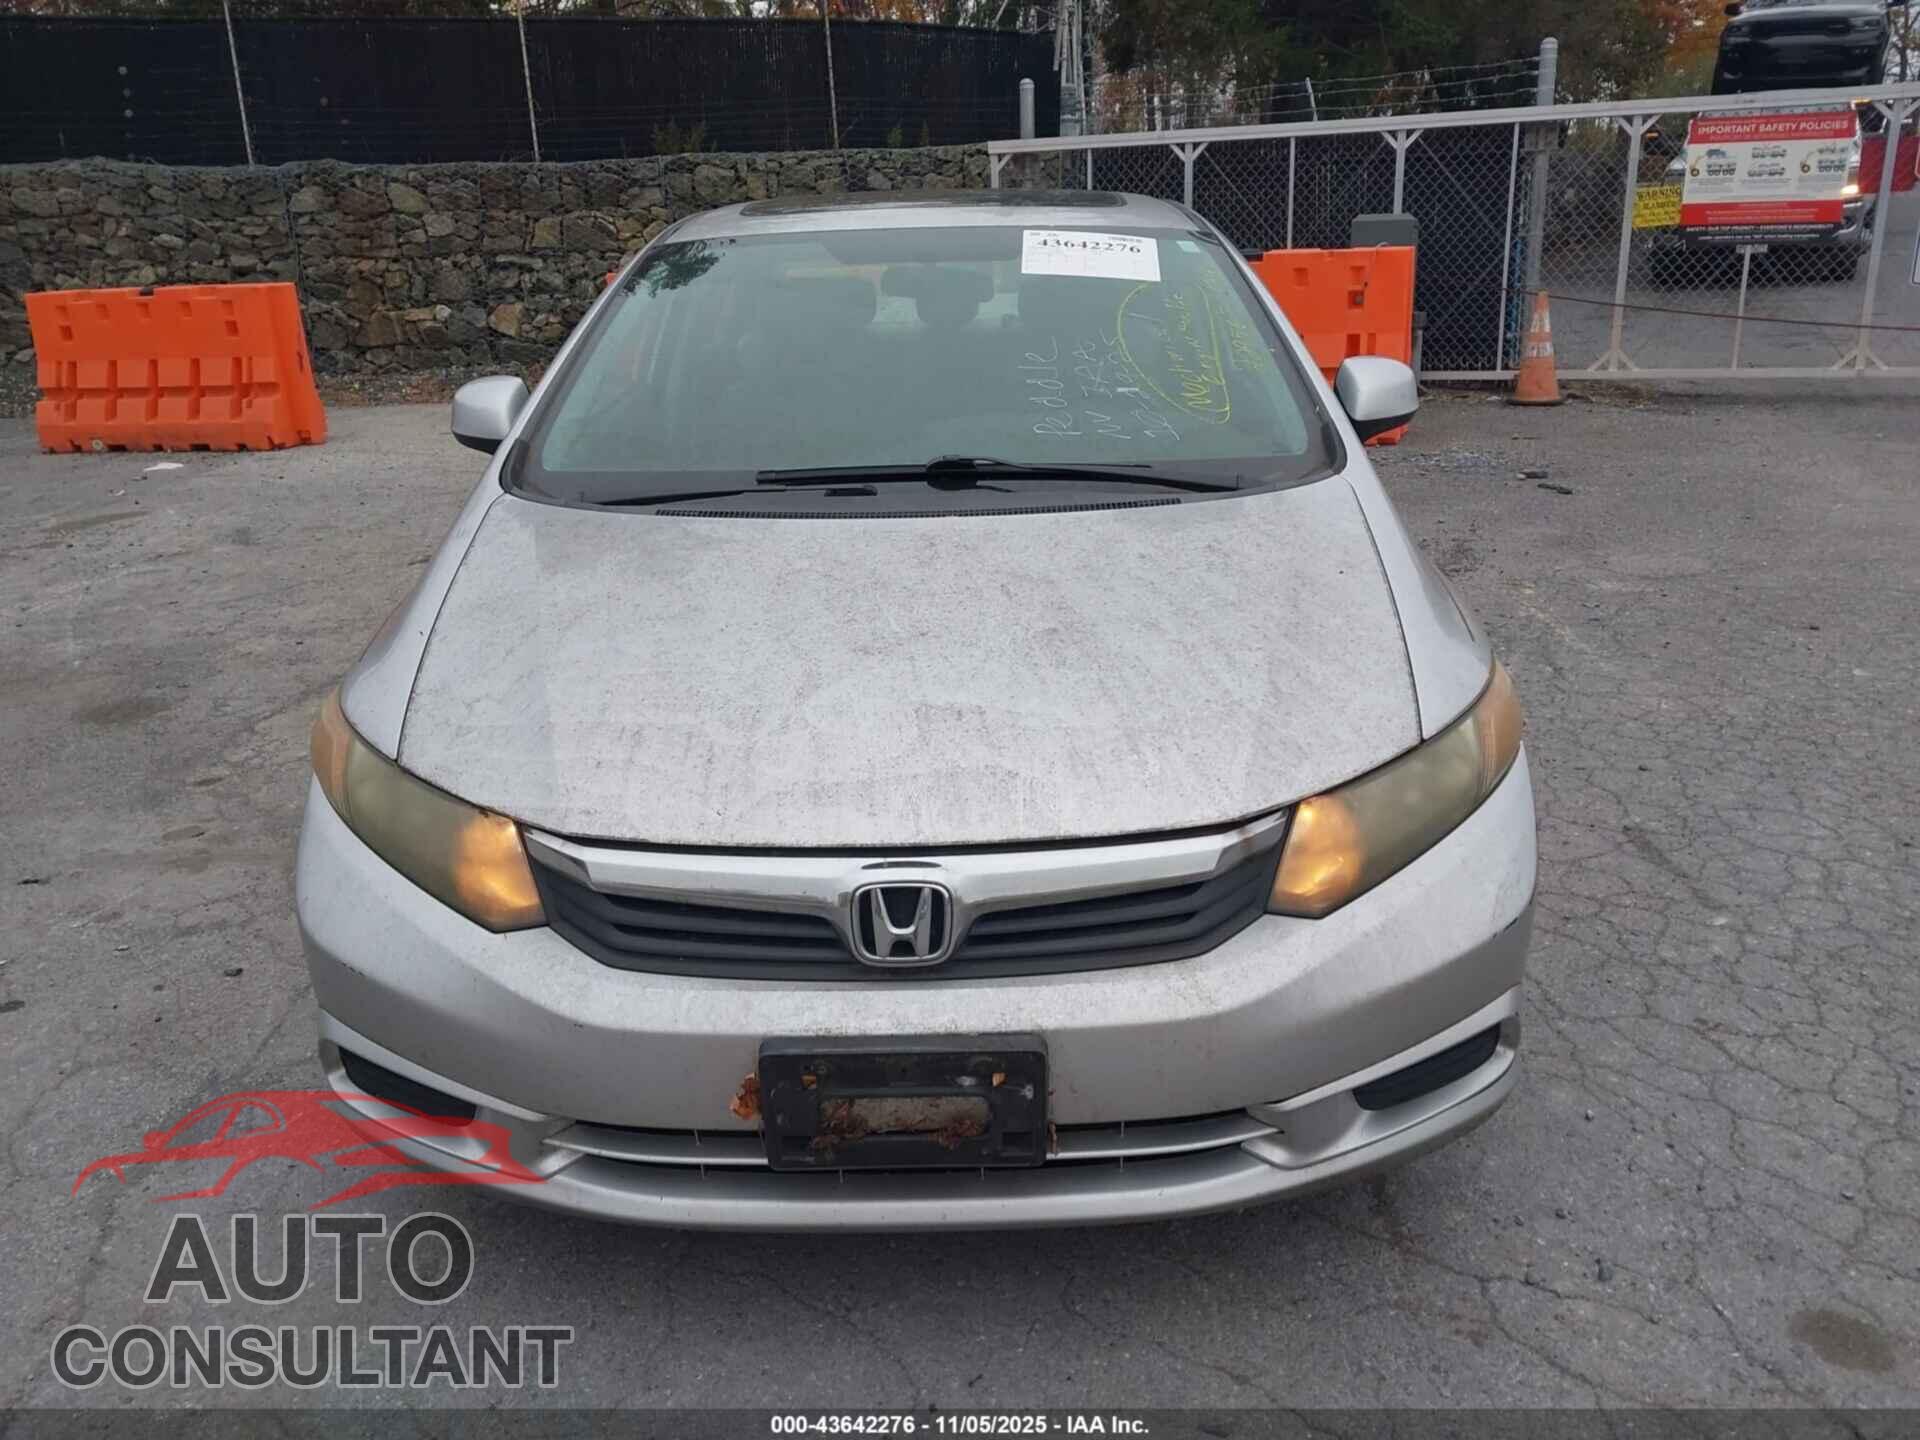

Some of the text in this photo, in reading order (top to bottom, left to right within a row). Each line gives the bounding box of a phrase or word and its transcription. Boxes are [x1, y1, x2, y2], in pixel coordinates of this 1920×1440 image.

[1698, 119, 1849, 135] IMPORTANT SAFETY POLICIES
[1037, 238, 1141, 254] 43642276
